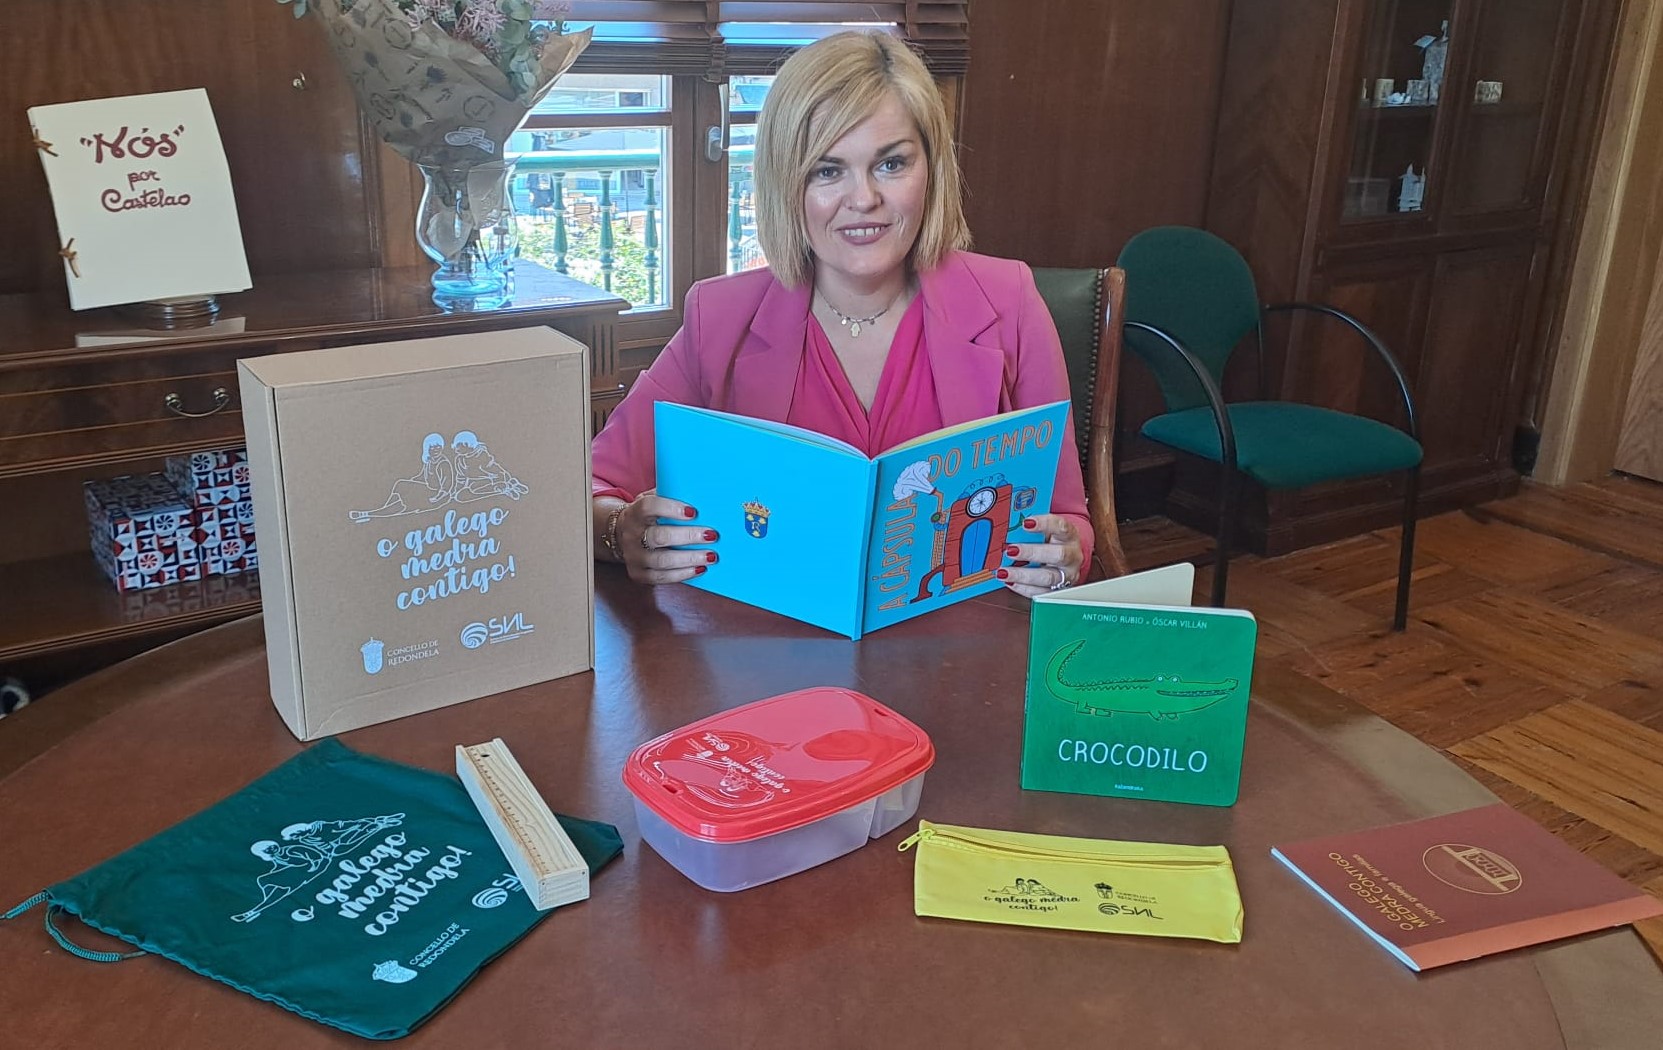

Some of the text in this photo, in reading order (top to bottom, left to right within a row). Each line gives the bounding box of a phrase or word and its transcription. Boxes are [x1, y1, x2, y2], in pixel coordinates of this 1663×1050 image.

[101, 188, 191, 212] Castelao
[127, 170, 161, 191] por
[927, 420, 1053, 483] DO TEMPO
[377, 508, 510, 557] o galego
[401, 537, 500, 580] medra
[396, 555, 516, 611] contigo!
[879, 593, 909, 612] A
[1082, 613, 1208, 629] ANTONIO RUBIO ÓSCAR VILLÁN
[386, 639, 439, 657] CONCELLO DE
[388, 648, 440, 666] REDONDELA
[1058, 739, 1208, 773] CROCODILO
[291, 831, 407, 922] o galego
[338, 846, 430, 919] medra
[364, 845, 472, 936] contigo!
[1328, 852, 1430, 928] MEDRA CONTIGO
[994, 896, 1036, 904] galego
[1349, 882, 1414, 931] O GALEGO
[409, 922, 460, 966] CONCELLO DE
[417, 928, 471, 968] REDONDELA
